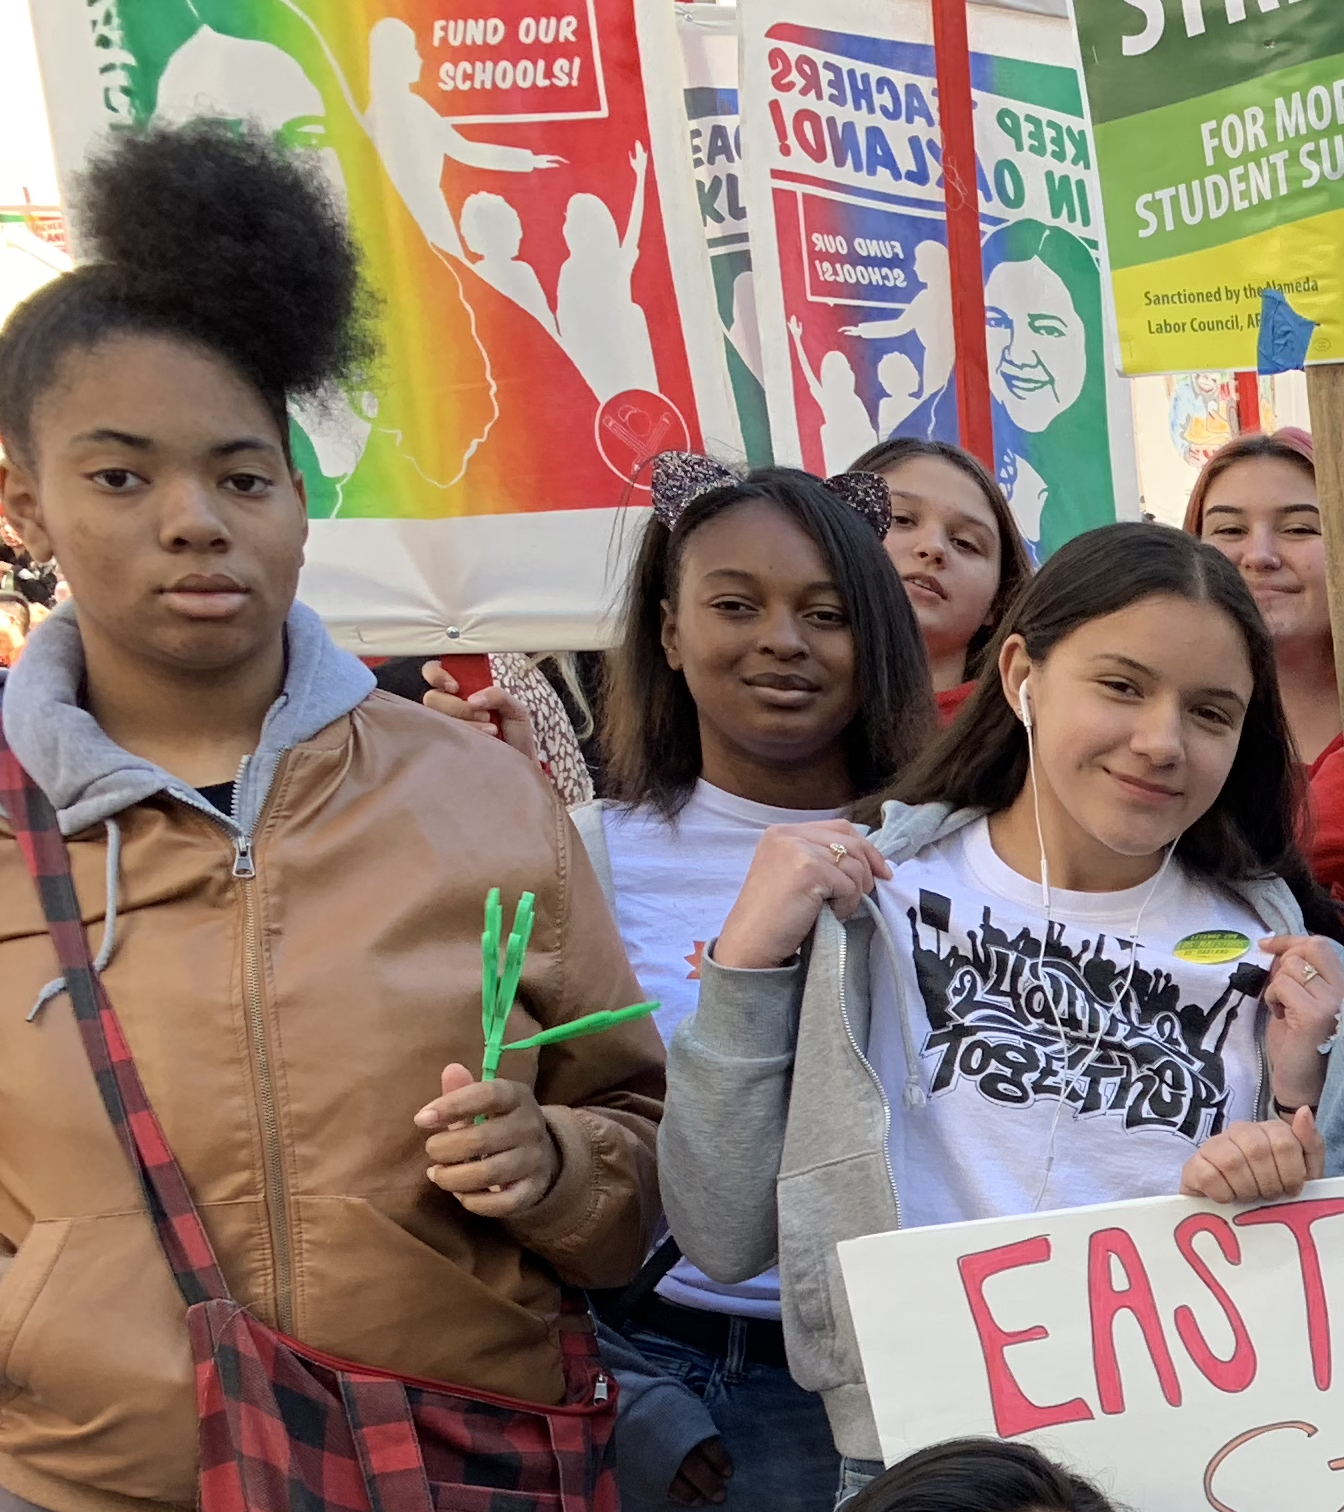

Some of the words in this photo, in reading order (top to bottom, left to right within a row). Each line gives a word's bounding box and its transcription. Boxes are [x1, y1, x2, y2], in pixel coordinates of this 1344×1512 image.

[432, 17, 506, 47] FUND
[518, 15, 578, 45] OUR
[438, 56, 581, 91] SCHOOLS!
[1200, 106, 1268, 167] FOR
[1135, 149, 1290, 239] STUDENT
[1144, 287, 1222, 306] Sanctioned
[1225, 286, 1241, 304] by
[1243, 282, 1263, 299] the
[1264, 276, 1319, 296] Alameda
[1147, 319, 1187, 335] Labor
[1190, 315, 1243, 333] Council,
